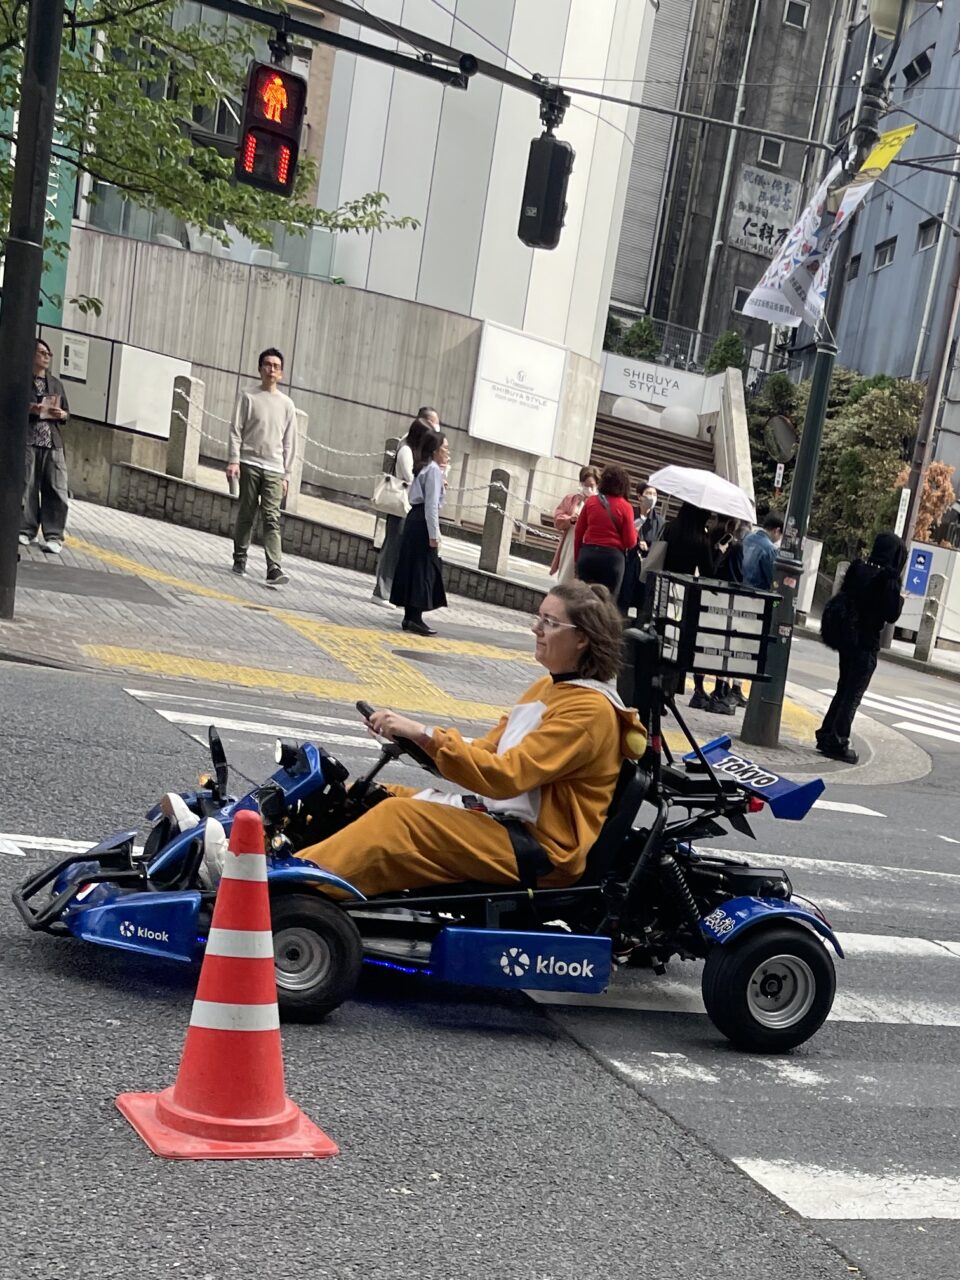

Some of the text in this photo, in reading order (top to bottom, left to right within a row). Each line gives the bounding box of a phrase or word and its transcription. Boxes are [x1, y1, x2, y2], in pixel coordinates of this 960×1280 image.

[623, 367, 680, 390] SHIBUYA
[628, 379, 669, 398] STYLE
[712, 755, 779, 788] Tokyo
[137, 926, 169, 943] klook
[536, 955, 594, 978] klook
